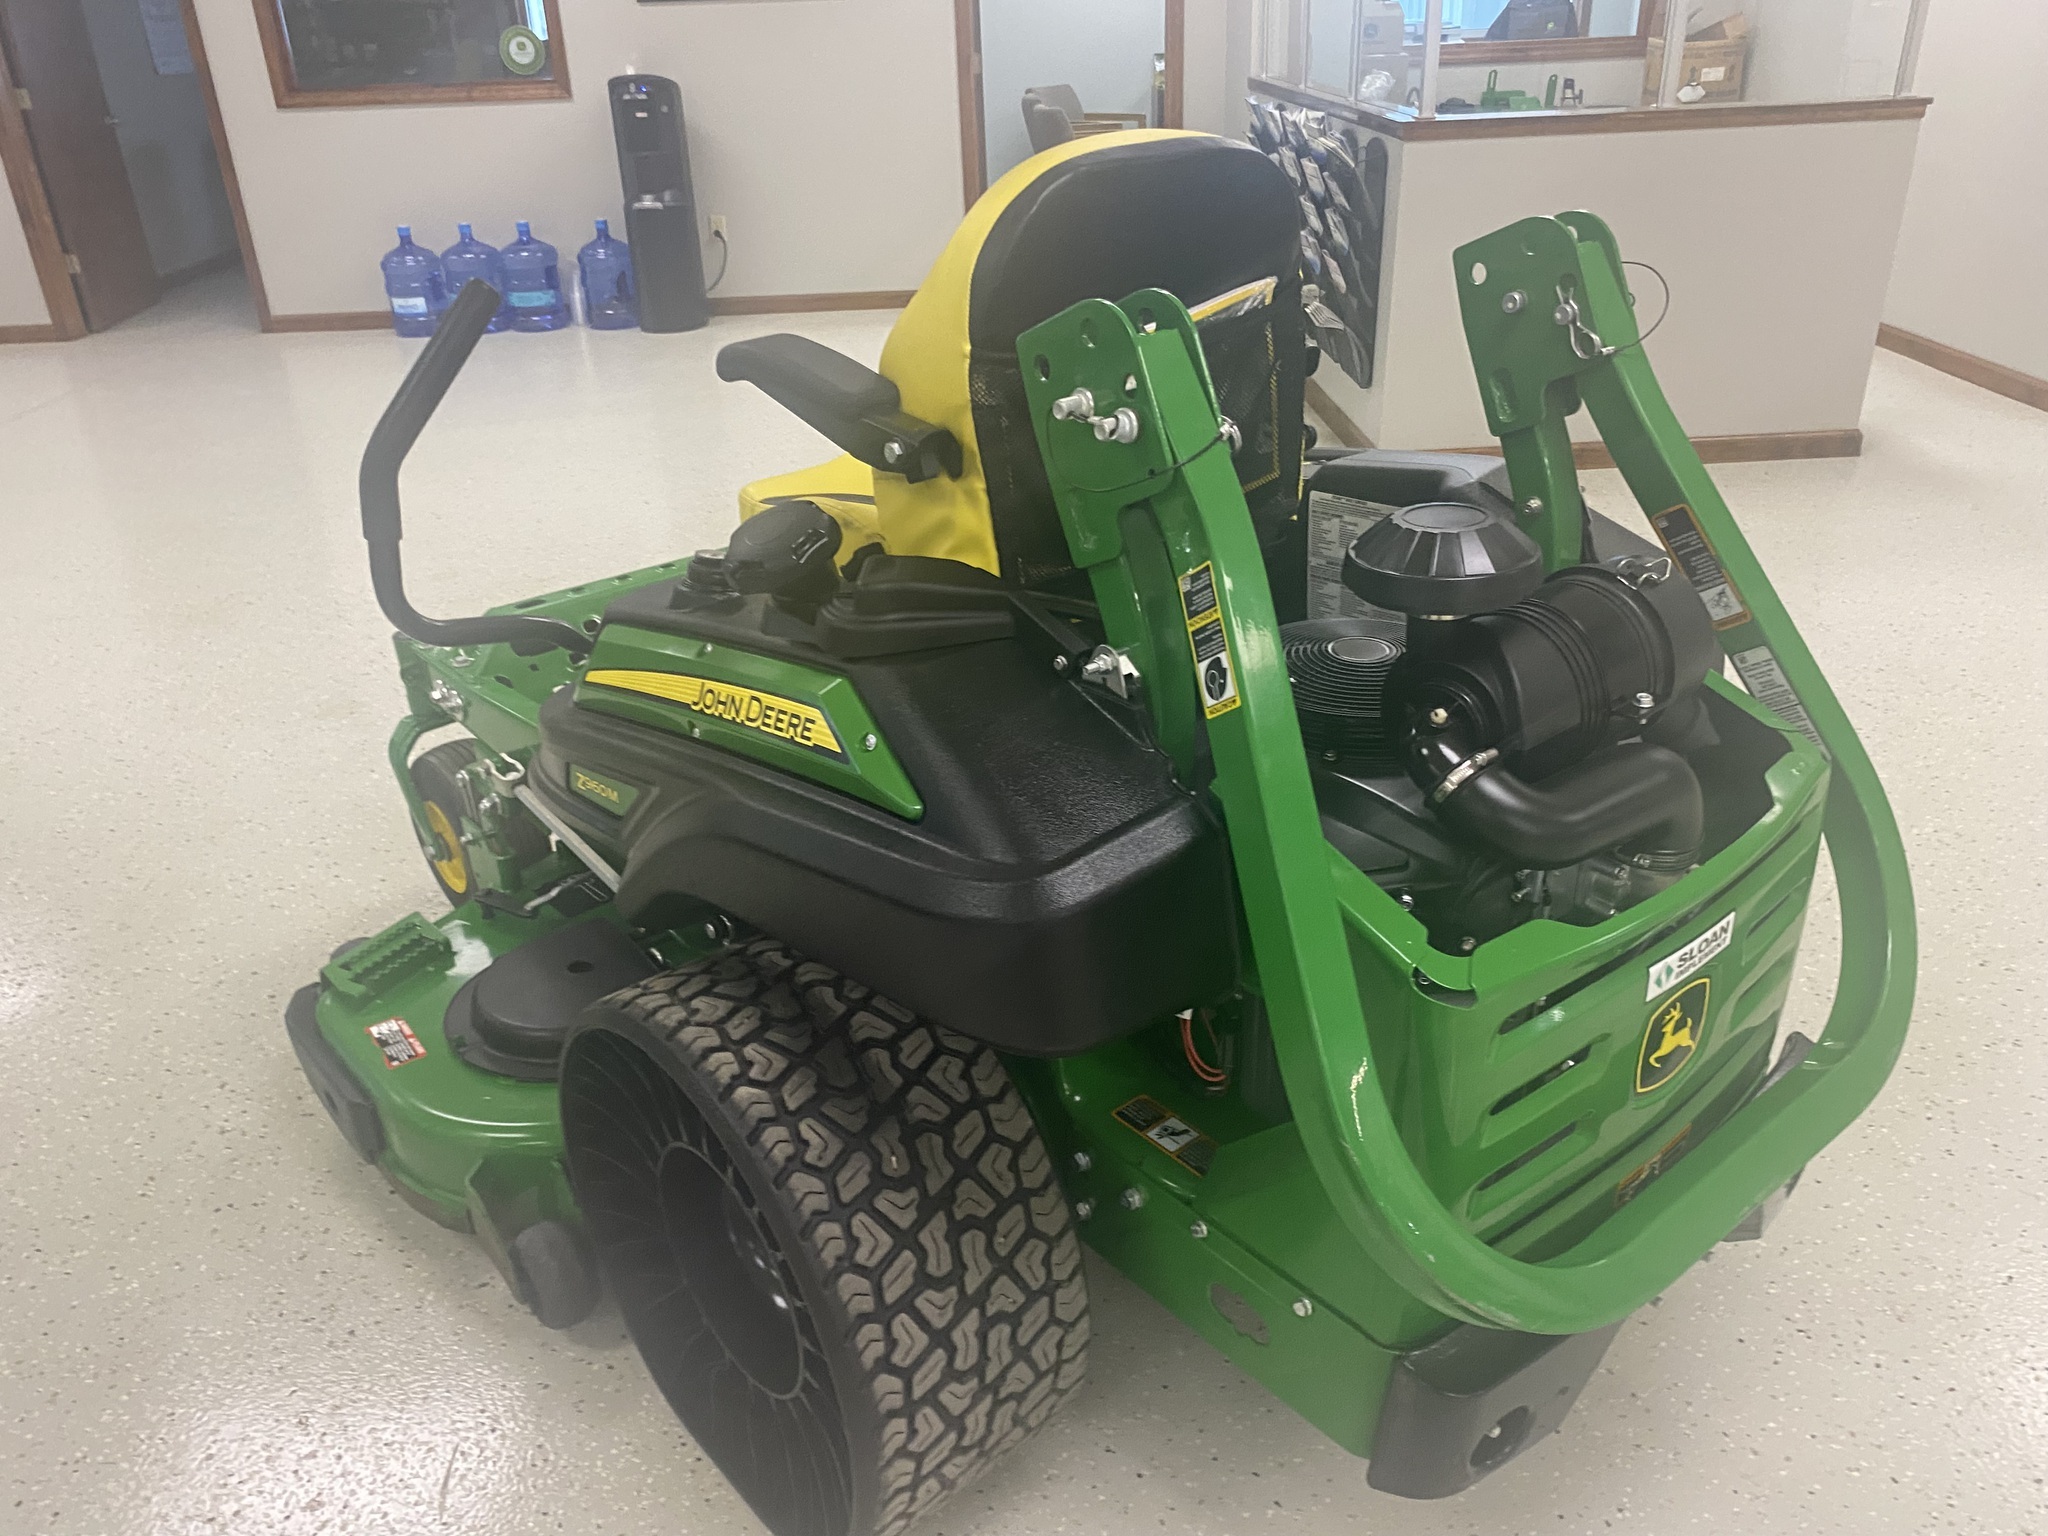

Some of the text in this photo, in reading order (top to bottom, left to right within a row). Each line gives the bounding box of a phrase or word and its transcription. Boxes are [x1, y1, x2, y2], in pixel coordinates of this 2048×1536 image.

[691, 681, 816, 744] JOHN DEERE
[1677, 920, 1730, 969] SLOAN
